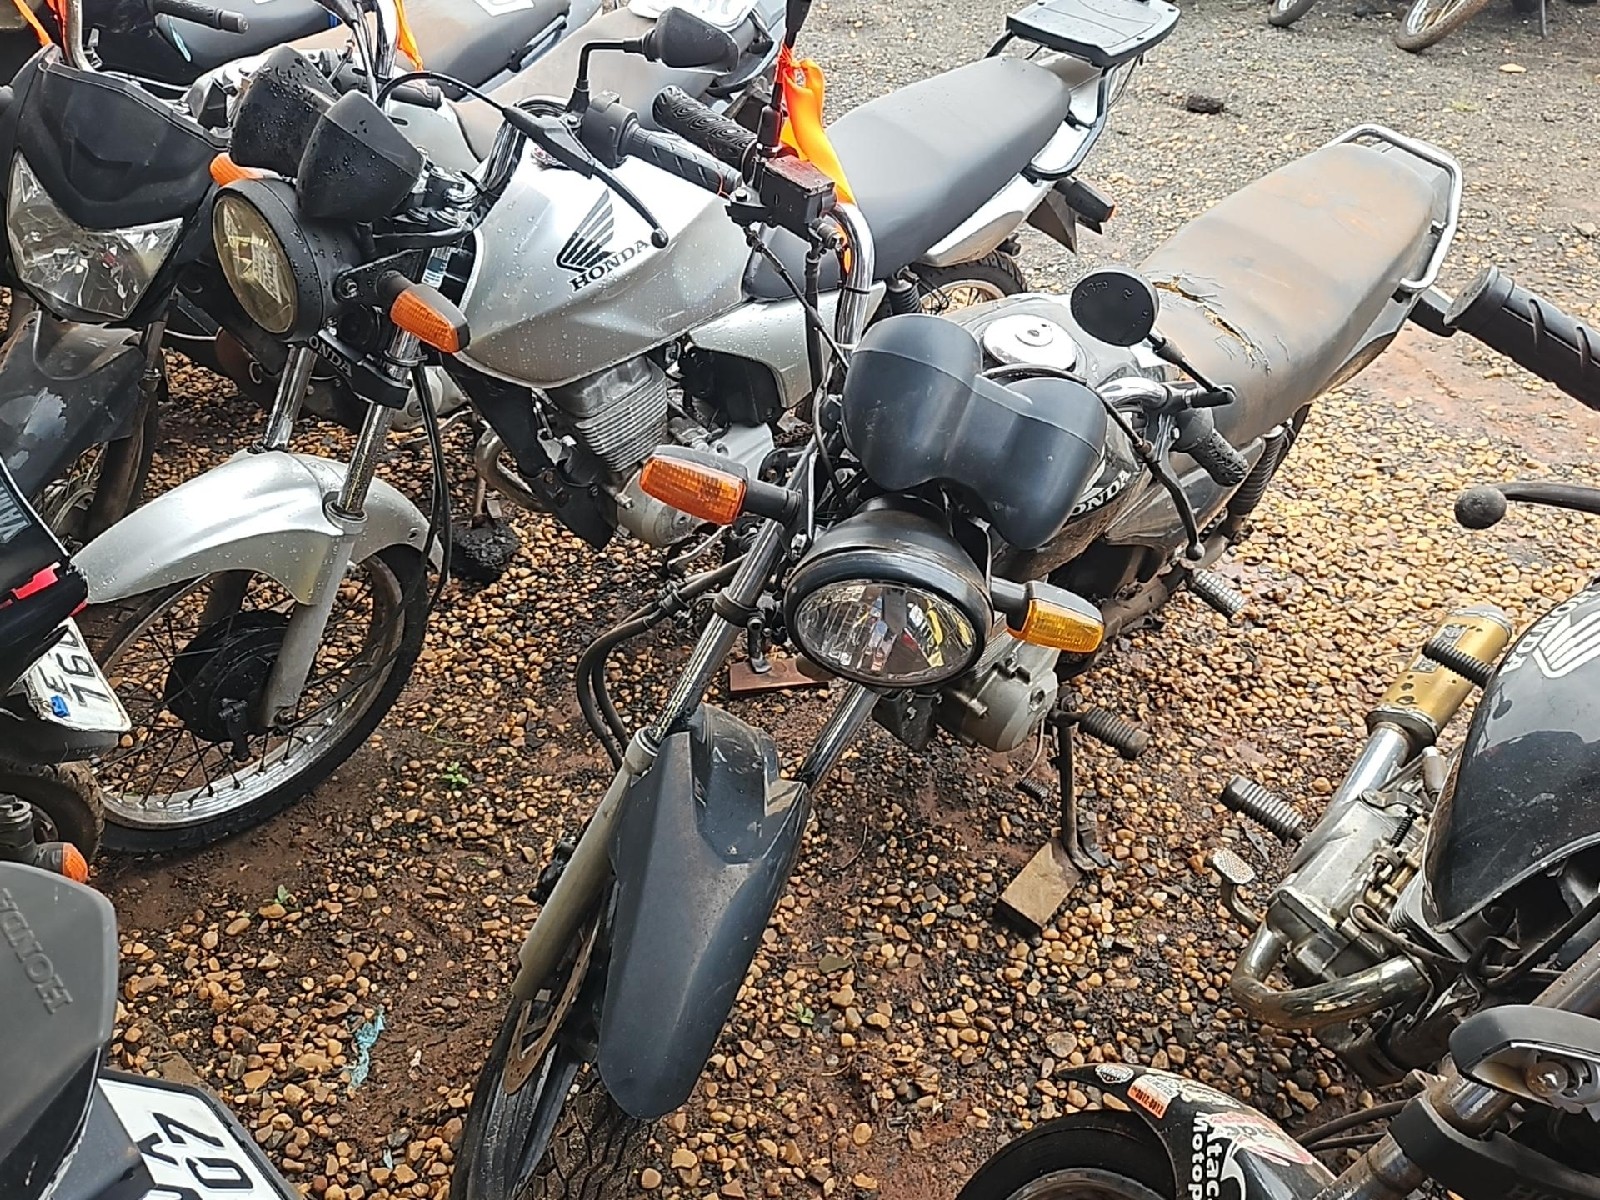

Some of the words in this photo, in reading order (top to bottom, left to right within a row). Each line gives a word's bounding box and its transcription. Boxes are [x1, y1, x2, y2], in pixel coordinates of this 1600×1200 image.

[569, 239, 651, 292] HONDA
[308, 335, 353, 378] ONDA
[1070, 469, 1132, 516] ONDA
